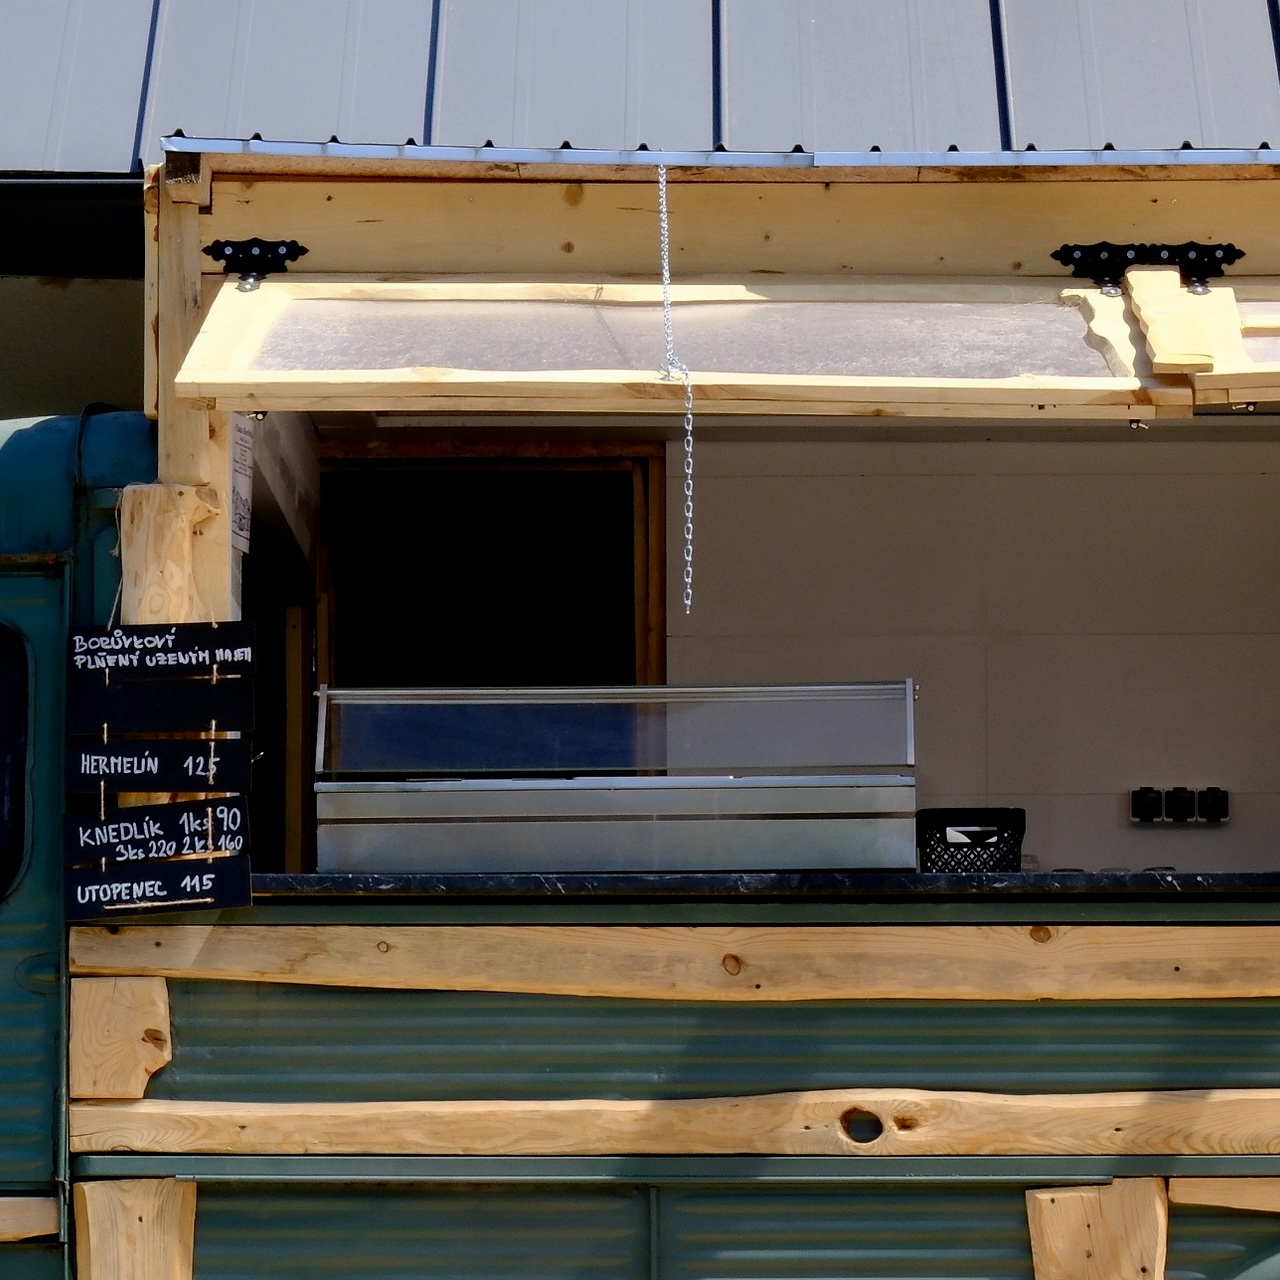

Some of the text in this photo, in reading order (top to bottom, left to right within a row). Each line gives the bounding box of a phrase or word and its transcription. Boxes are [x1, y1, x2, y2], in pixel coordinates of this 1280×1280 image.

[81, 750, 220, 776] HERMELÍN 125
[216, 806, 241, 831] 90
[148, 840, 177, 858] 220
[218, 835, 244, 850] 160
[76, 874, 216, 904] UTOPENEC 115
